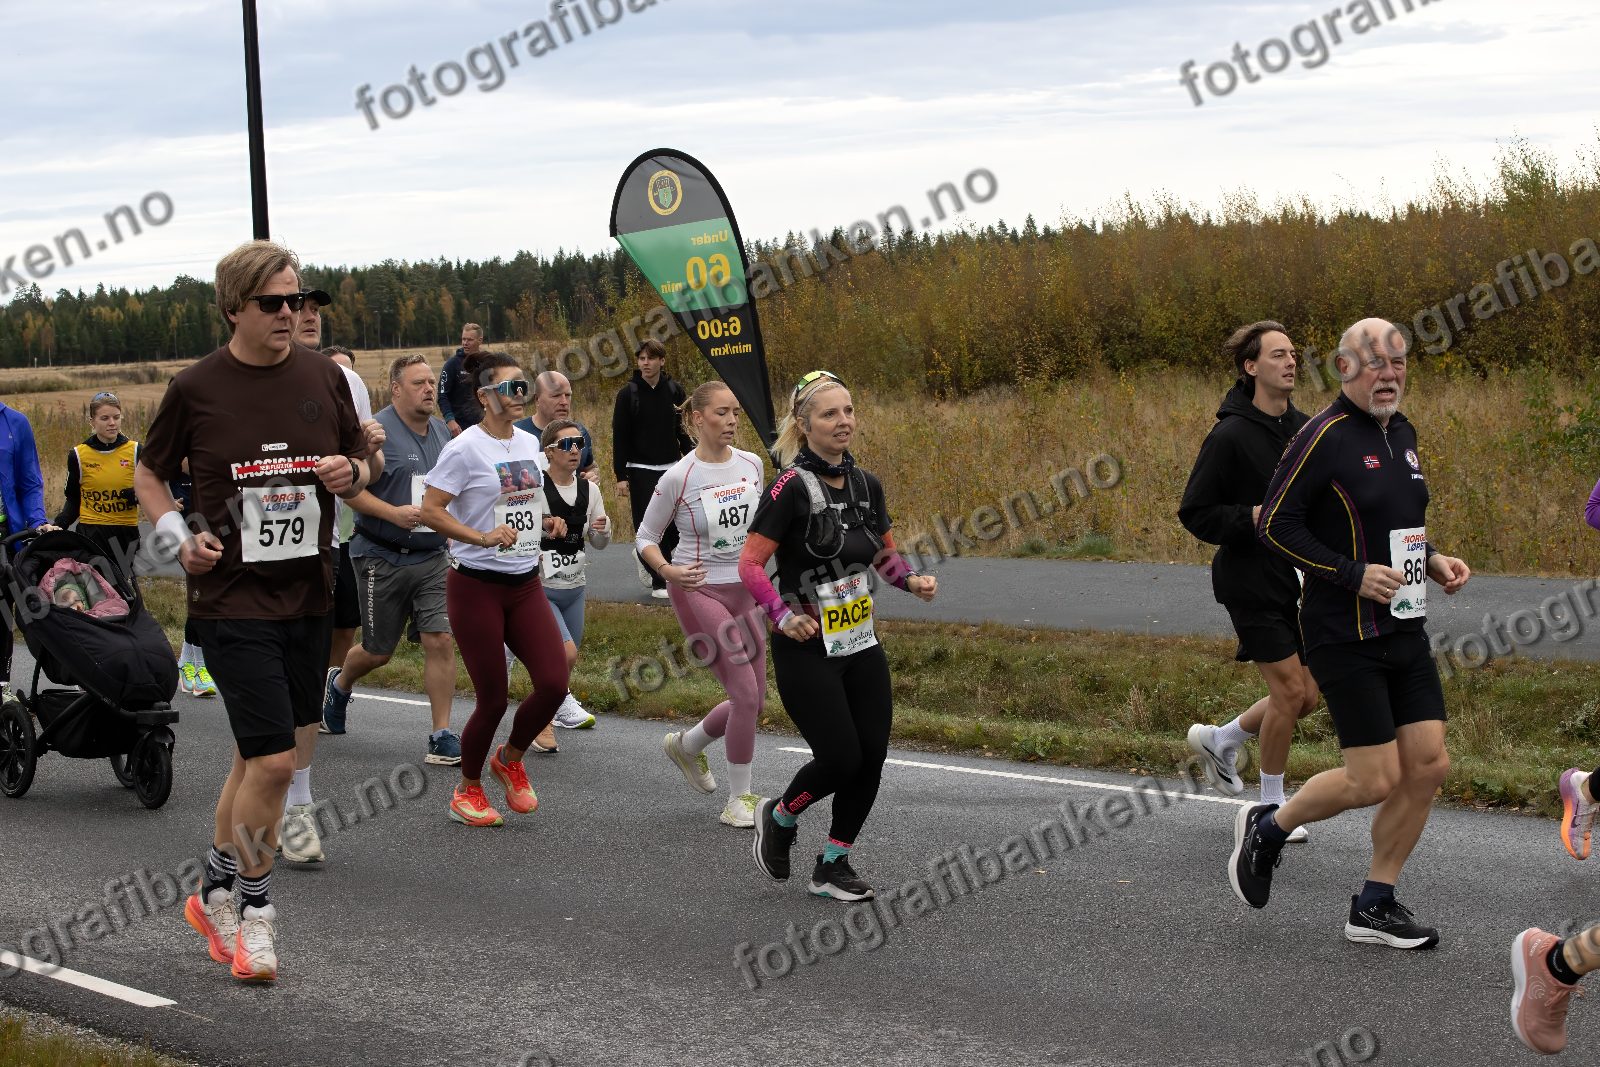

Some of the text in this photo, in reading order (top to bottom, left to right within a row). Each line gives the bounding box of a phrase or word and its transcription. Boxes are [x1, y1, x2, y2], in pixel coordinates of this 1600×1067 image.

[262, 492, 305, 502] NORGES
[714, 486, 745, 498] NORGES
[718, 493, 742, 503] LØPET
[265, 502, 300, 511] LØPET
[505, 510, 534, 531] 583
[718, 504, 749, 528] 487
[258, 516, 304, 547] 579
[827, 599, 869, 630] PACE
